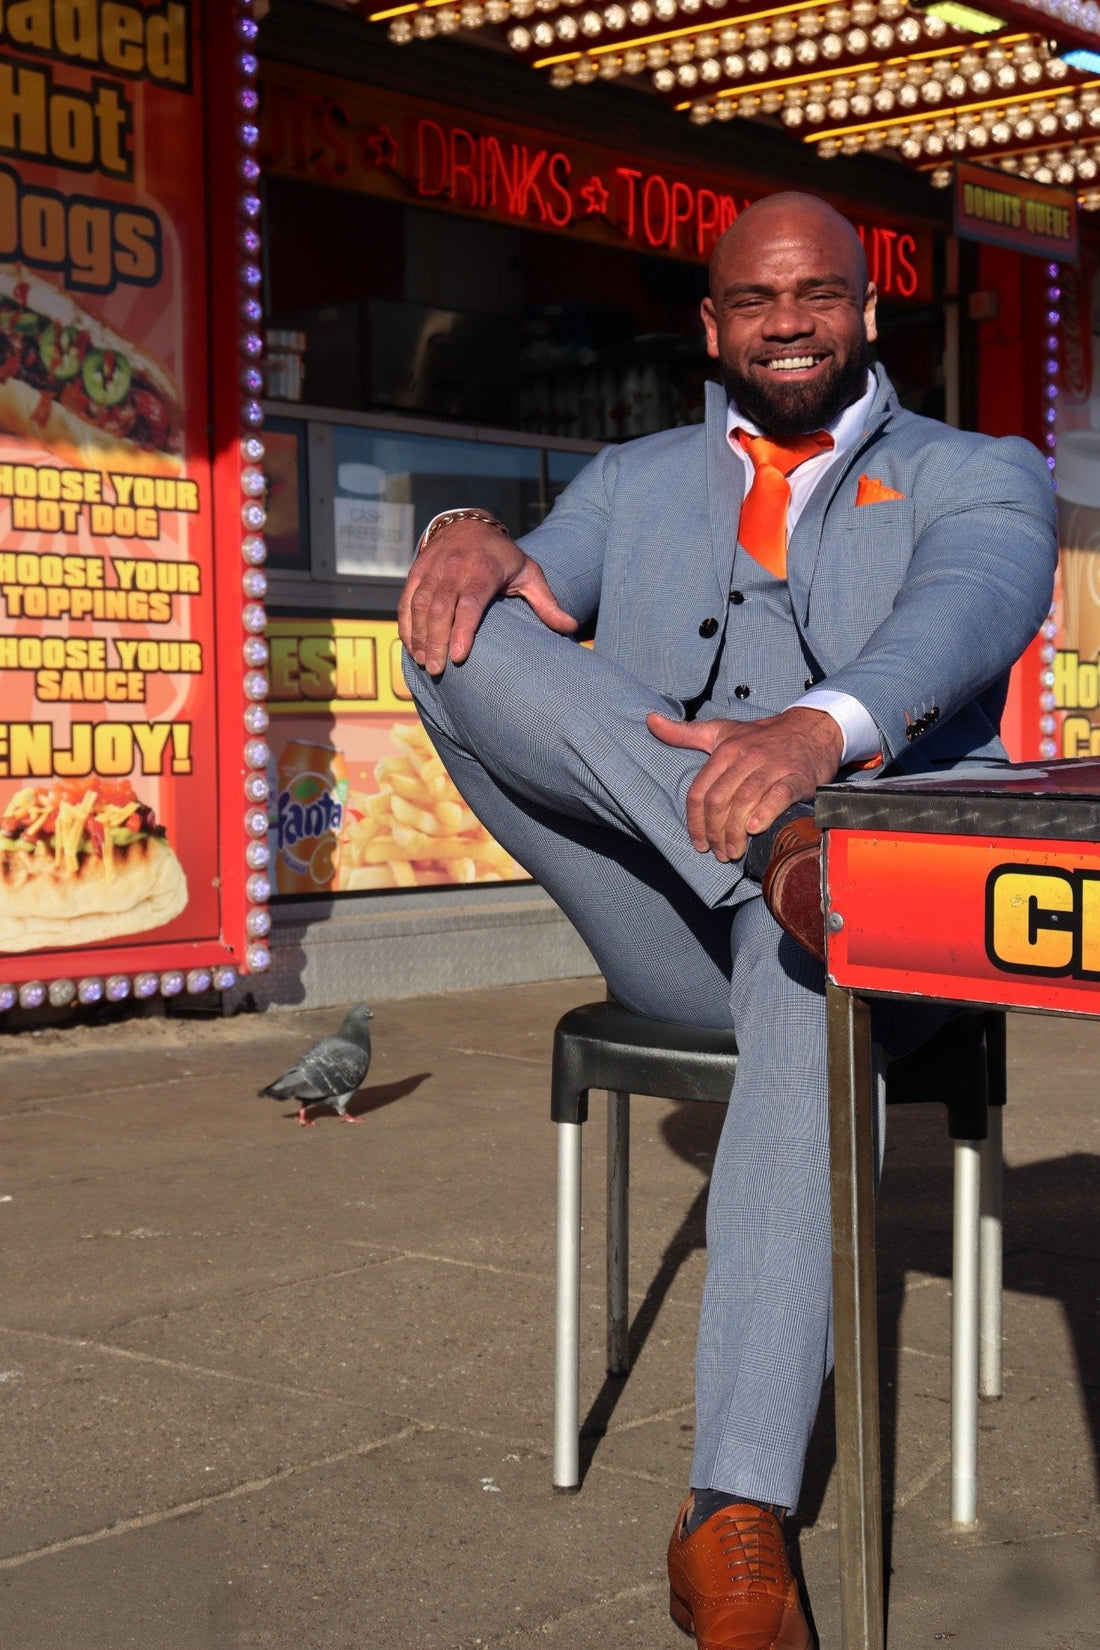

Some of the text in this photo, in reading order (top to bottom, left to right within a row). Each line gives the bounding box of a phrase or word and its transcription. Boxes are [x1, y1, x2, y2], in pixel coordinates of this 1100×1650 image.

[0, 0, 190, 88] aded
[0, 59, 131, 176] Hot
[418, 119, 572, 226] DRINKS
[111, 471, 200, 512] YOUR
[12, 498, 160, 540] HOT DOG
[111, 558, 202, 595] YOUR
[2, 586, 173, 623] TOPPINGS
[112, 640, 203, 674] YOUR
[35, 671, 146, 703] SAUCE
[1053, 651, 1100, 708] Ho
